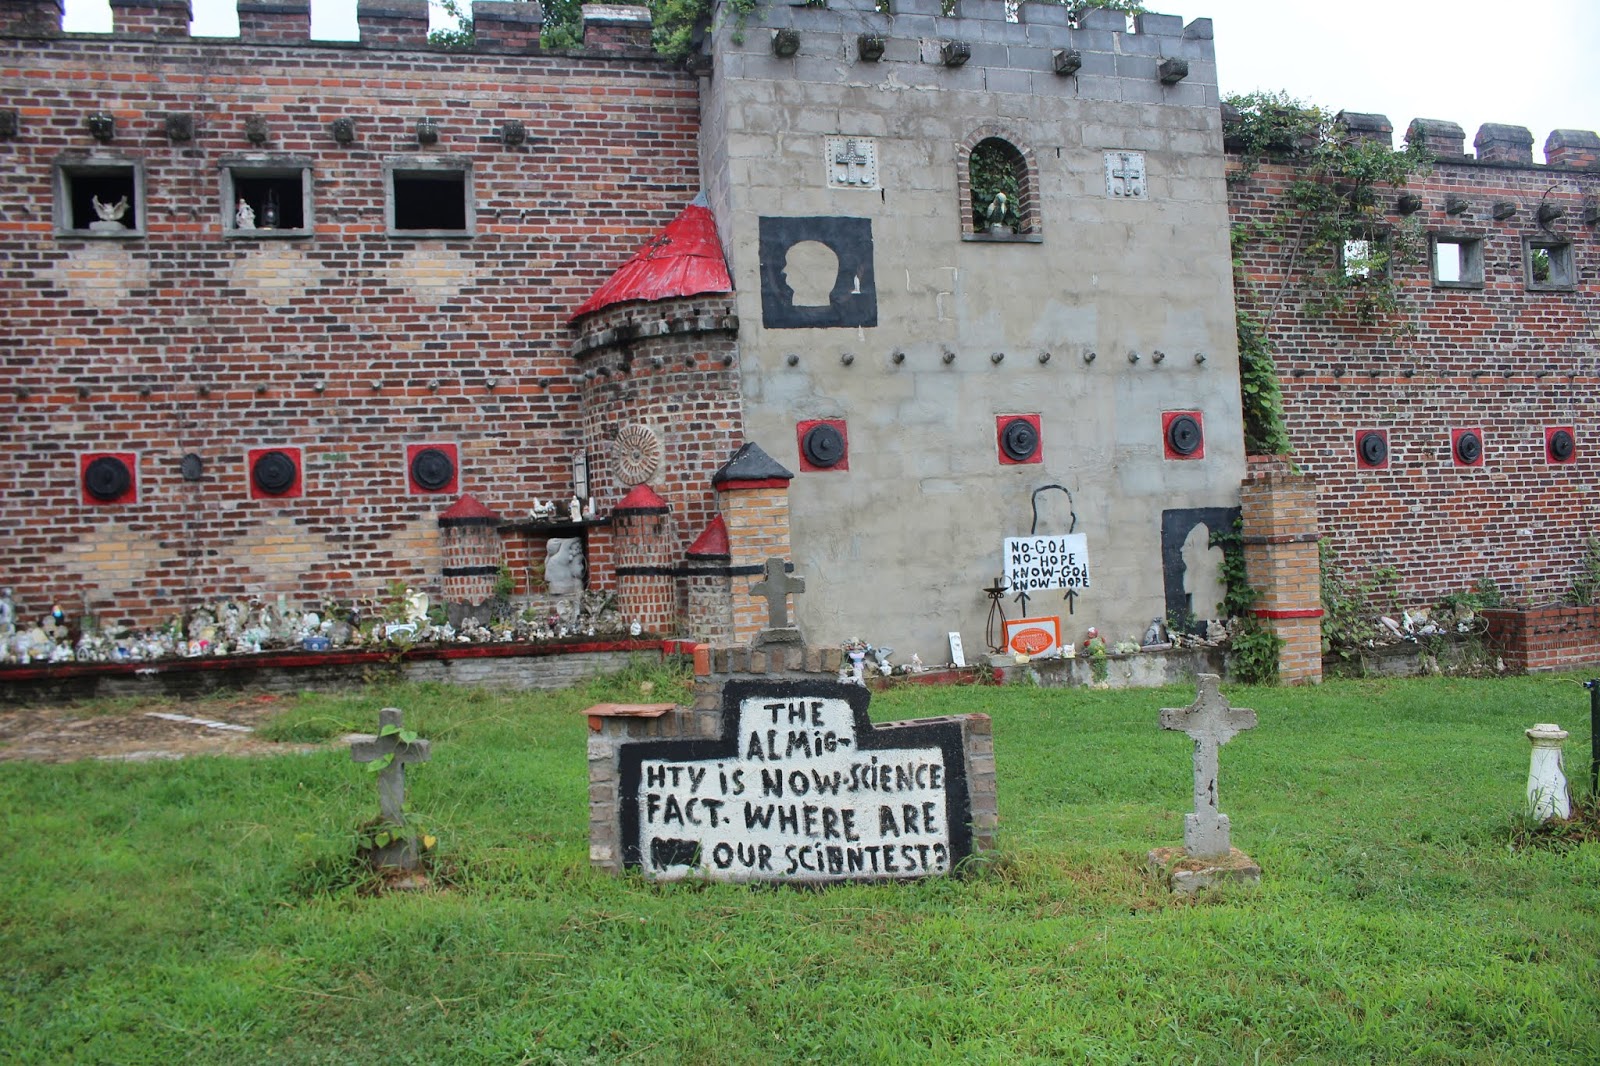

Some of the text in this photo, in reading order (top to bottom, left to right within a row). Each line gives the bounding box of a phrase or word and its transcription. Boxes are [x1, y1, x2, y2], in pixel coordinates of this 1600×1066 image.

[763, 701, 826, 727] THE
[647, 765, 706, 793] HTY
[647, 794, 940, 843] FACT. WHERE ARE
[712, 842, 773, 871] OUR
